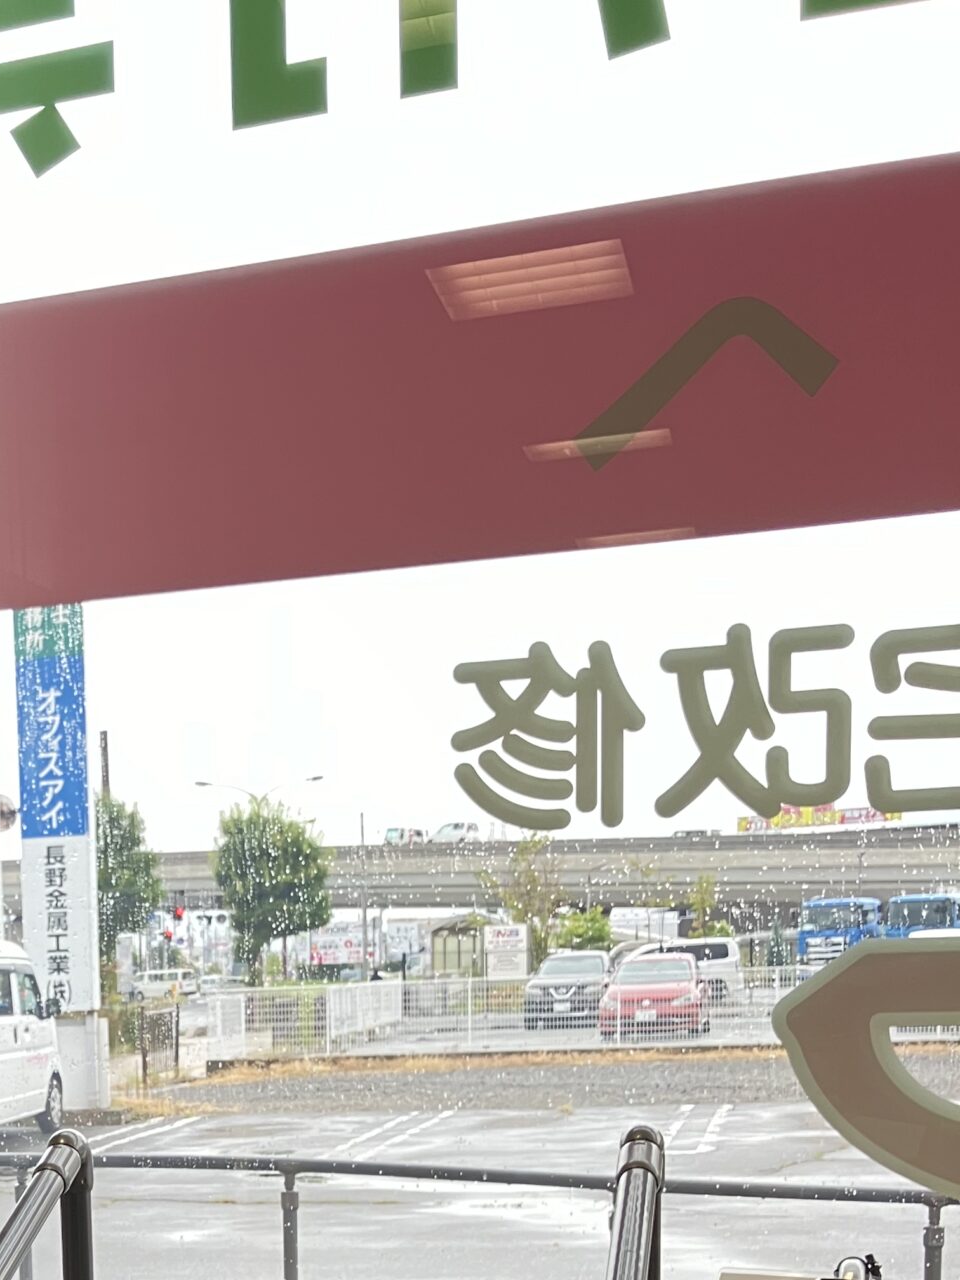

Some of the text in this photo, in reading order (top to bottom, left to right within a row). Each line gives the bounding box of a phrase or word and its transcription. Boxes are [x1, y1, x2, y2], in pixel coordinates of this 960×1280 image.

[38, 687, 64, 830] オフィスアイ
